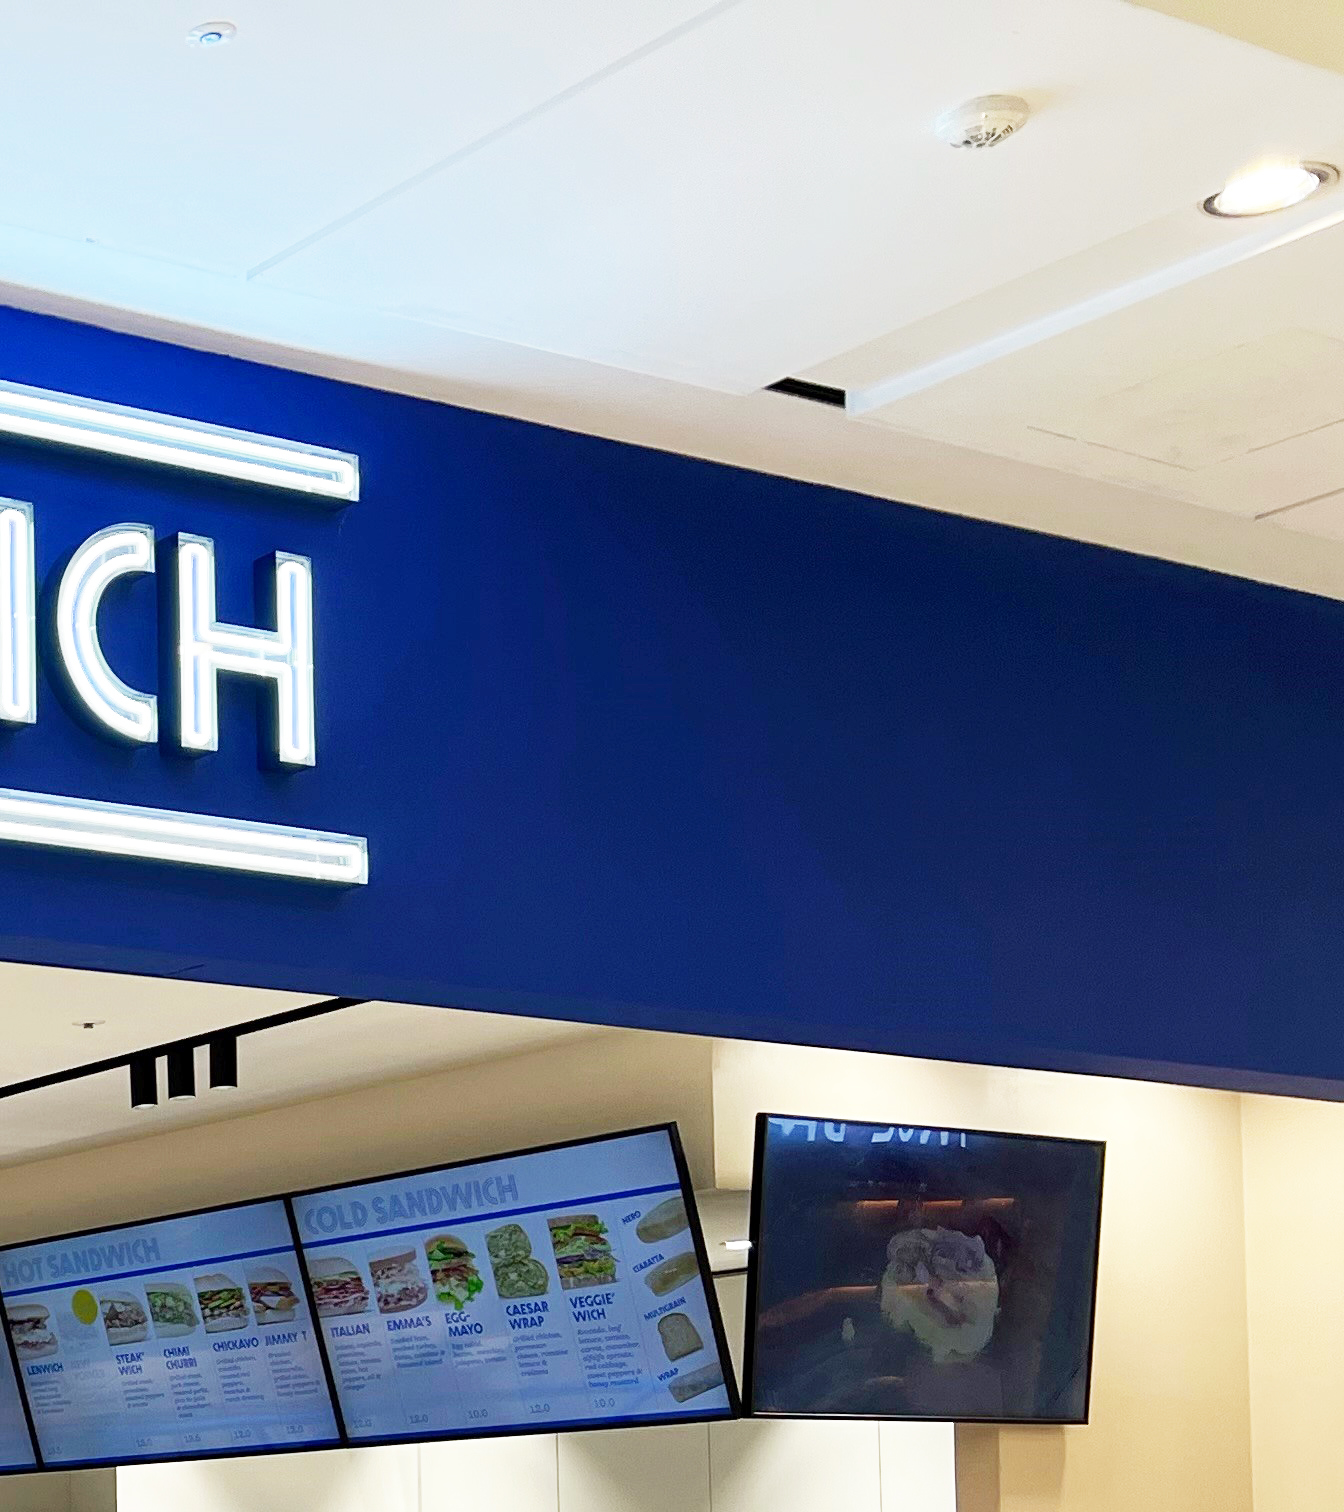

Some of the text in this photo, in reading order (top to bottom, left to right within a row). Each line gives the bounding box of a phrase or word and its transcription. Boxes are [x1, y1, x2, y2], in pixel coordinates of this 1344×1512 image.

[304, 1174, 519, 1235] COLD SANDWICH
[622, 1210, 641, 1225] HERO
[2, 1237, 161, 1286] HOT SANDWICH
[506, 1301, 549, 1317] CAESAR
[572, 1308, 606, 1323] WICH
[386, 1315, 432, 1332] EMMA'S
[448, 1323, 483, 1337] MAYO
[508, 1315, 545, 1330] WRAP
[330, 1323, 370, 1338] ITALIAN
[213, 1337, 259, 1352] CHICKAVO
[164, 1346, 190, 1359] CHIMI
[26, 1362, 64, 1376] LENWICH
[118, 1365, 142, 1376] WICH
[657, 1367, 679, 1382] WRAP
